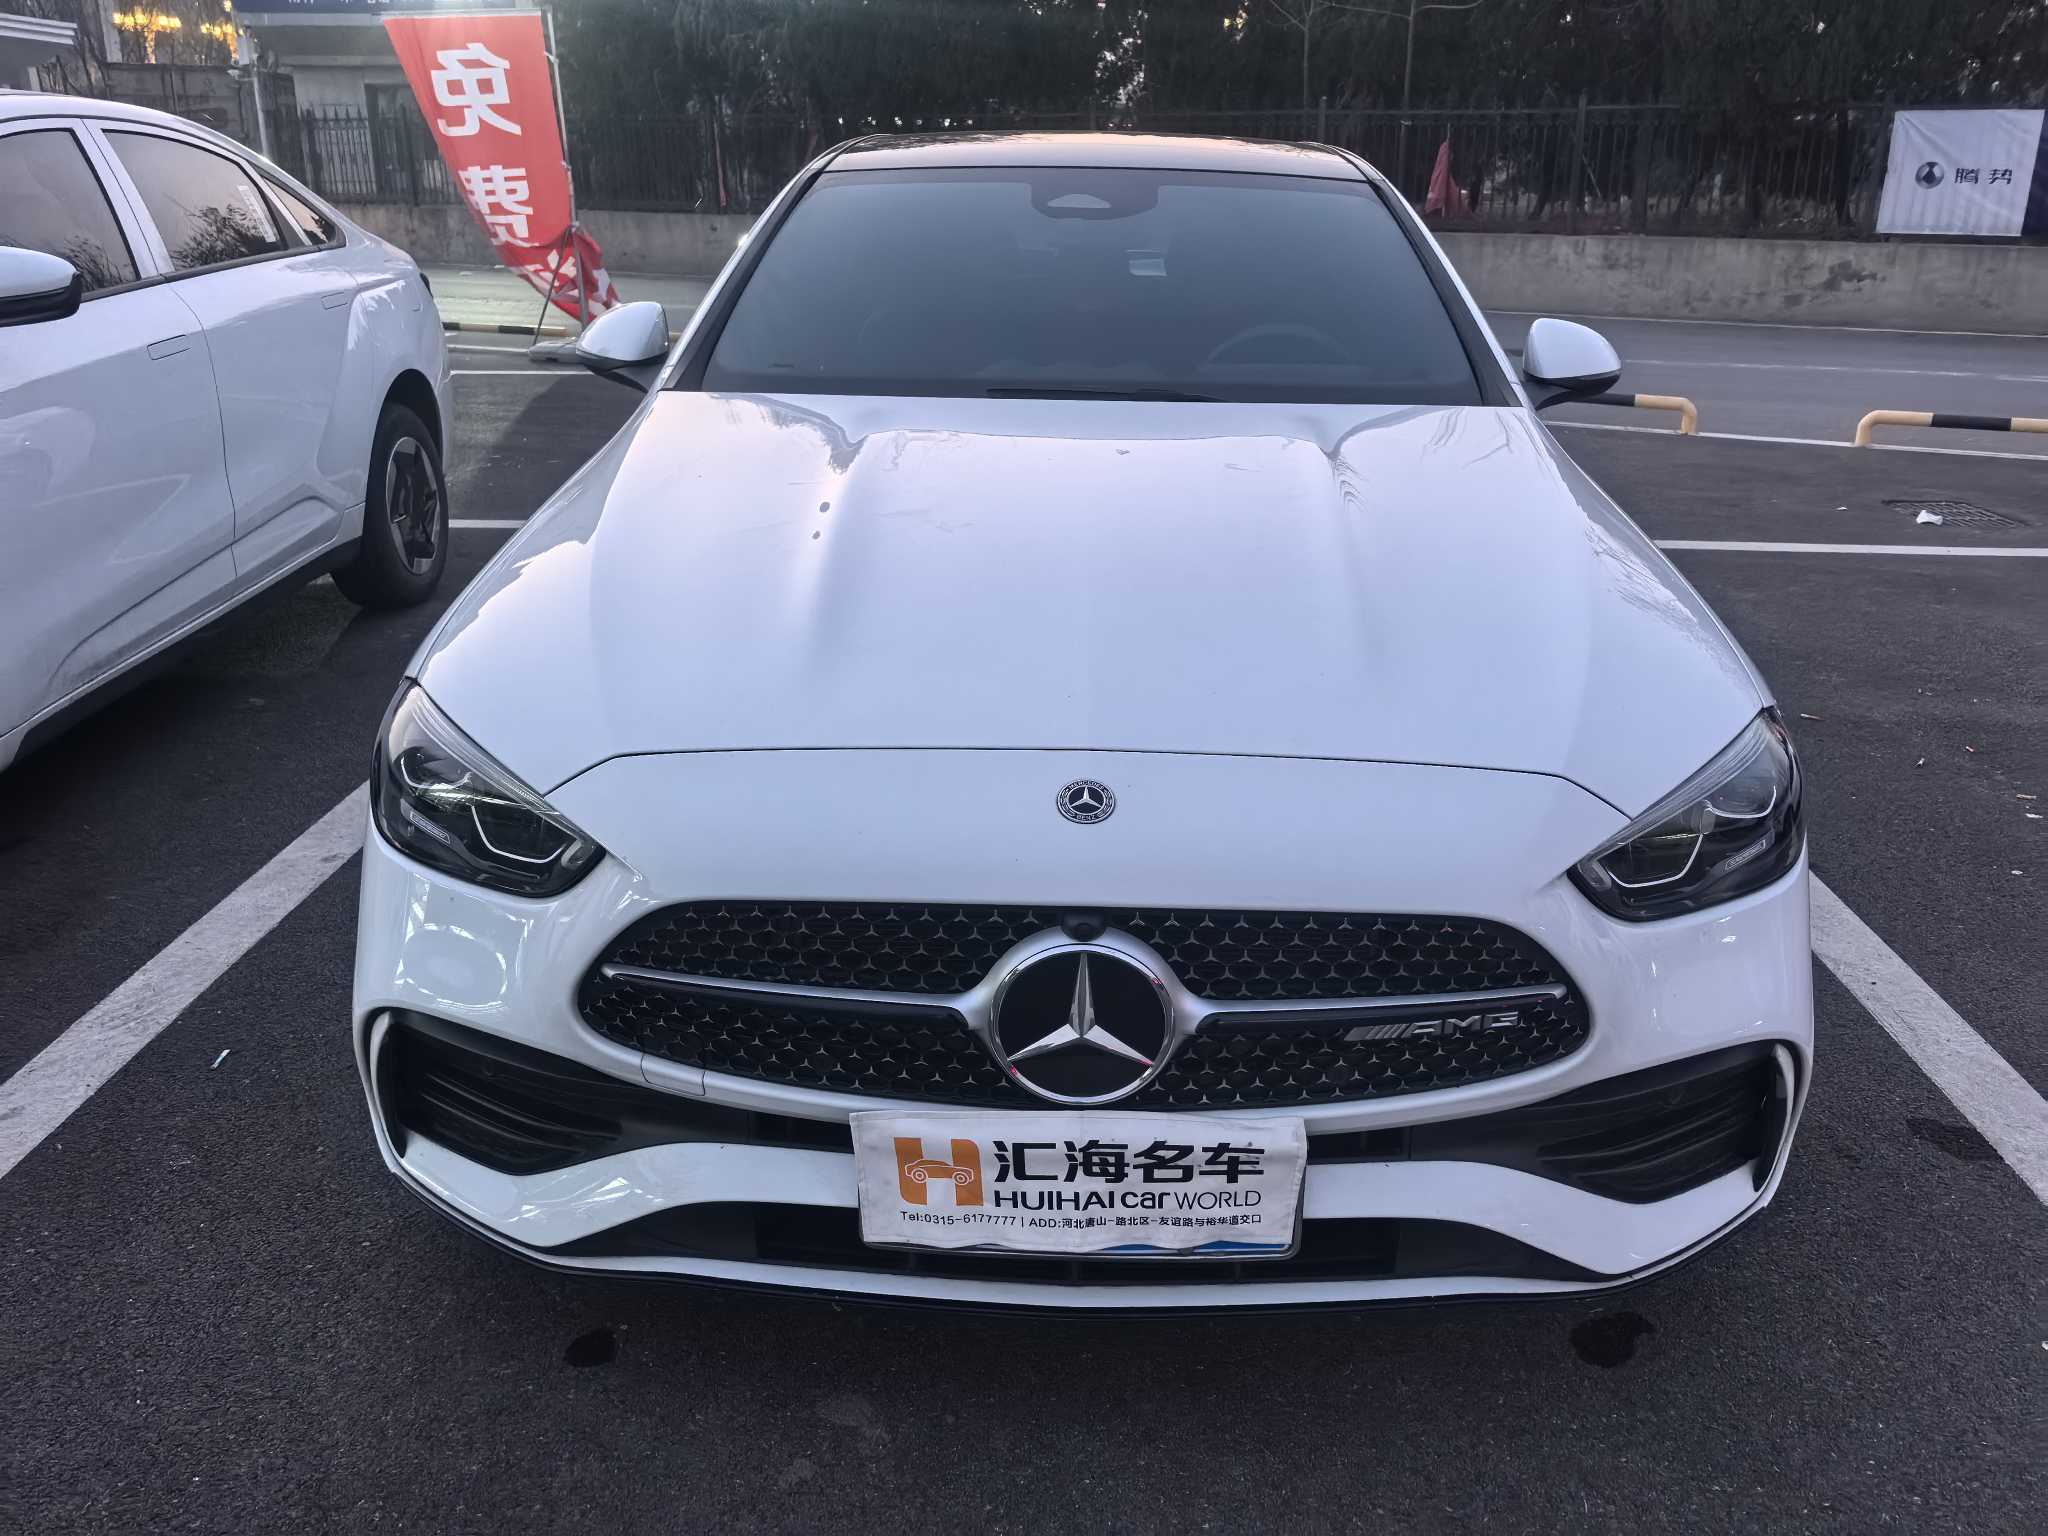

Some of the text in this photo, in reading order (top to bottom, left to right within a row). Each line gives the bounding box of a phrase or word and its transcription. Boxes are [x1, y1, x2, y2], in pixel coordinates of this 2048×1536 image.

[1954, 167, 2013, 185] 腾势
[1402, 1011, 1519, 1038] AMG
[992, 1139, 1265, 1184] 汇海名车
[1173, 1190, 1262, 1211] WORLD
